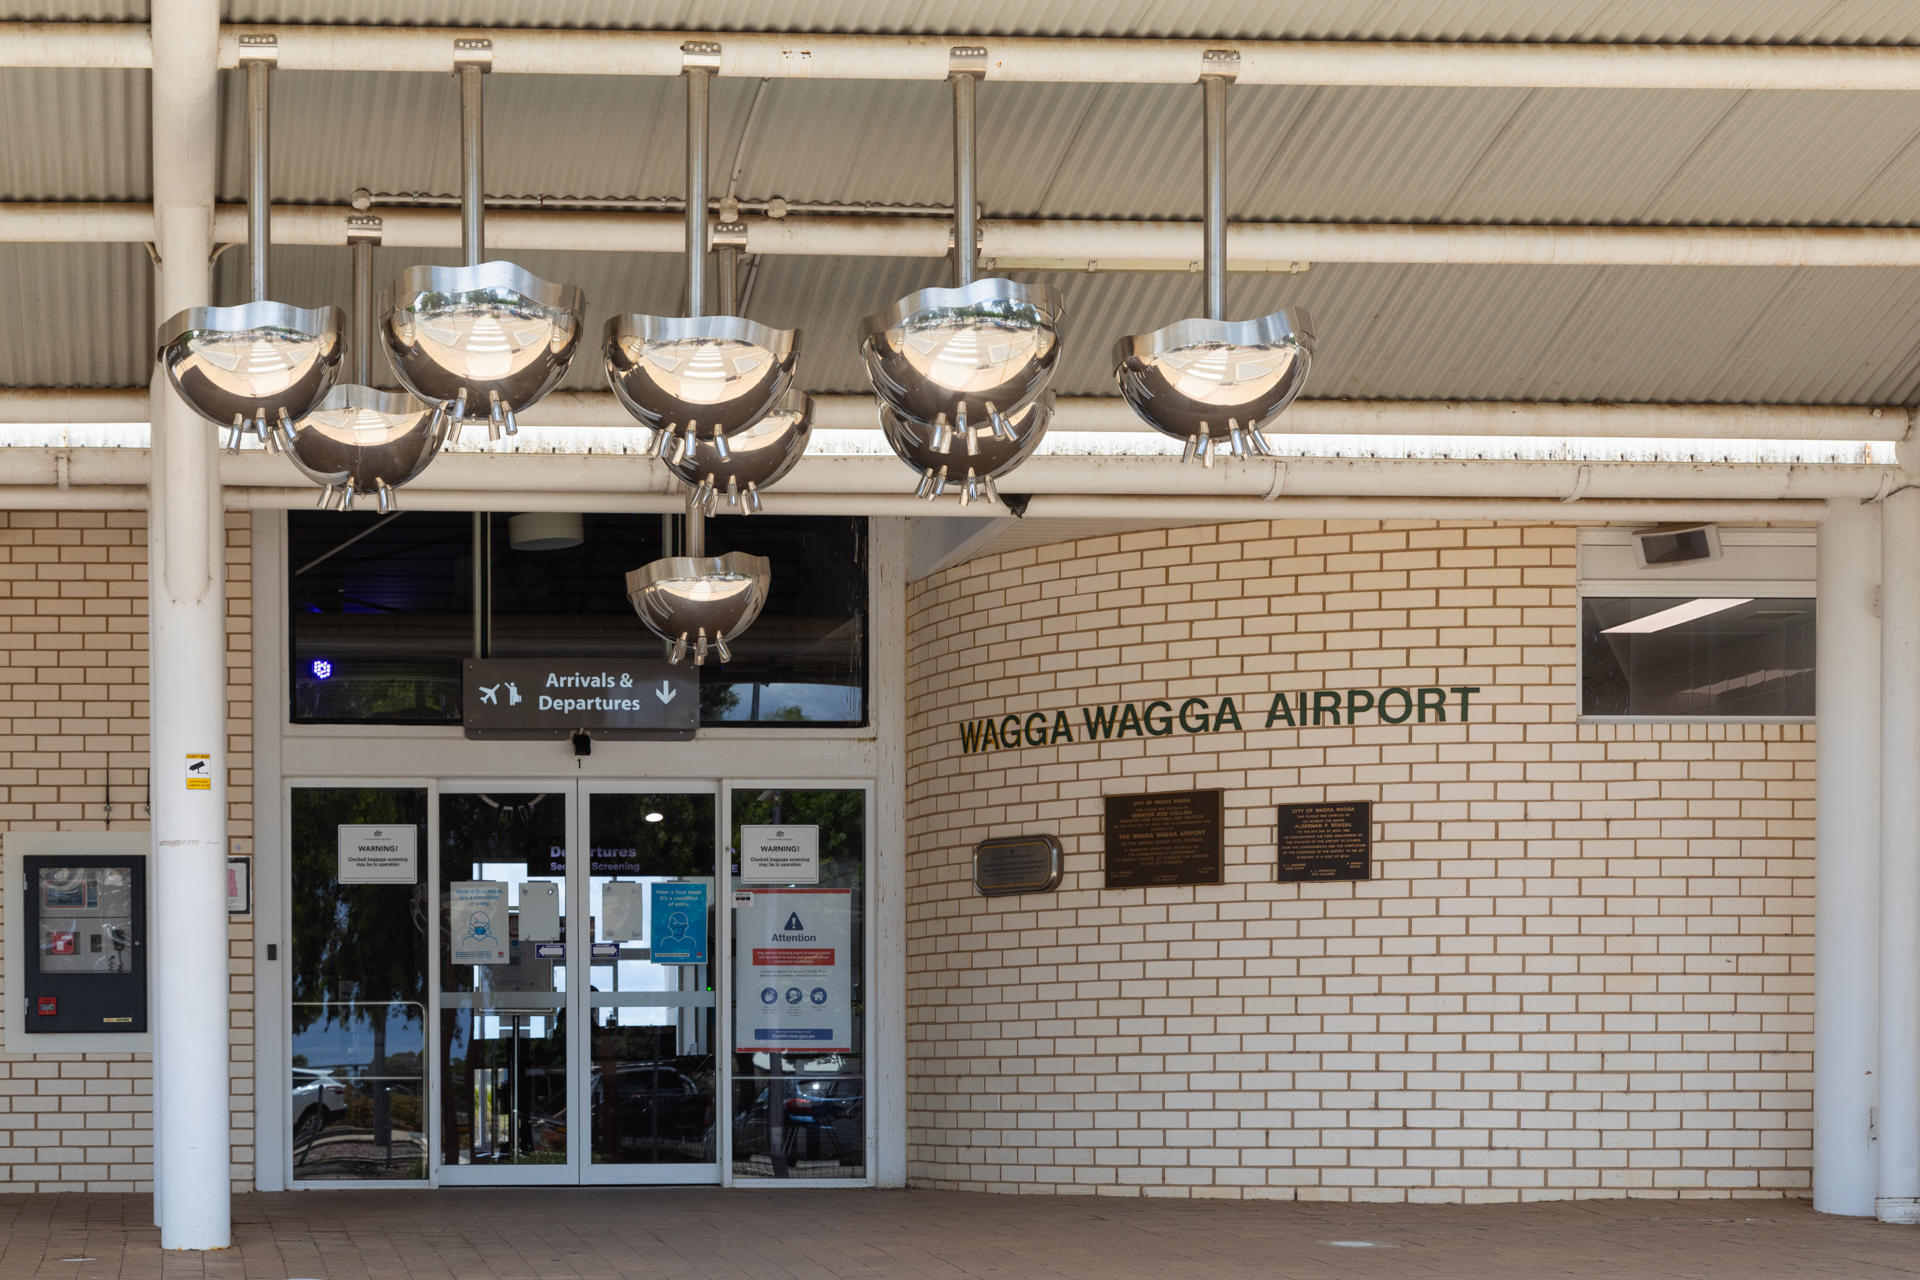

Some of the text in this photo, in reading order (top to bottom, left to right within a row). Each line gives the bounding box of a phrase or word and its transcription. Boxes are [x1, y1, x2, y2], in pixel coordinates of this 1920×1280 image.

[546, 672, 633, 688] Arrivals &
[539, 695, 640, 714] Departures
[960, 687, 1480, 753] WAGGA WAGGA AIRPORT
[576, 758, 581, 769] 1
[591, 862, 640, 872] Screening
[771, 933, 816, 942] Attention
